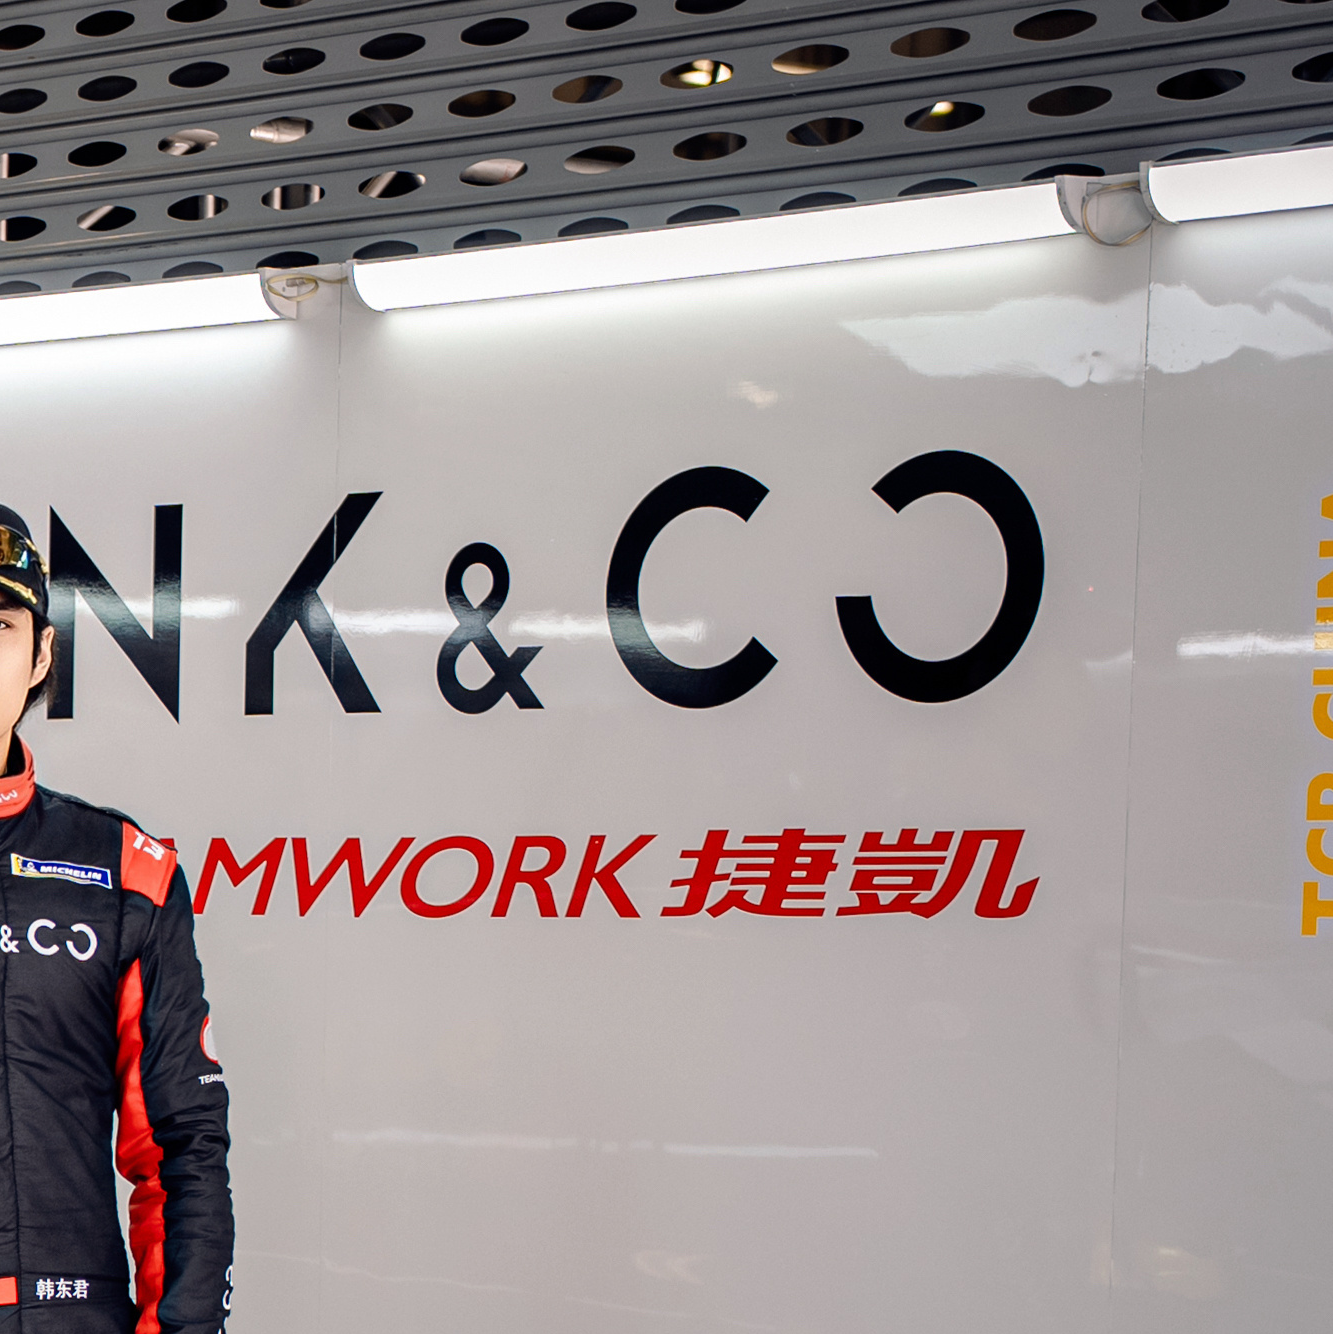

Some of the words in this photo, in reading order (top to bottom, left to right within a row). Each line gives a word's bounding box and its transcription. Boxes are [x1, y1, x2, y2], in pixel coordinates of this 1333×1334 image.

[39, 865, 102, 881] MICHELIN
[661, 828, 1041, 920] 捷凱
[35, 1278, 90, 1300] 韩东君
